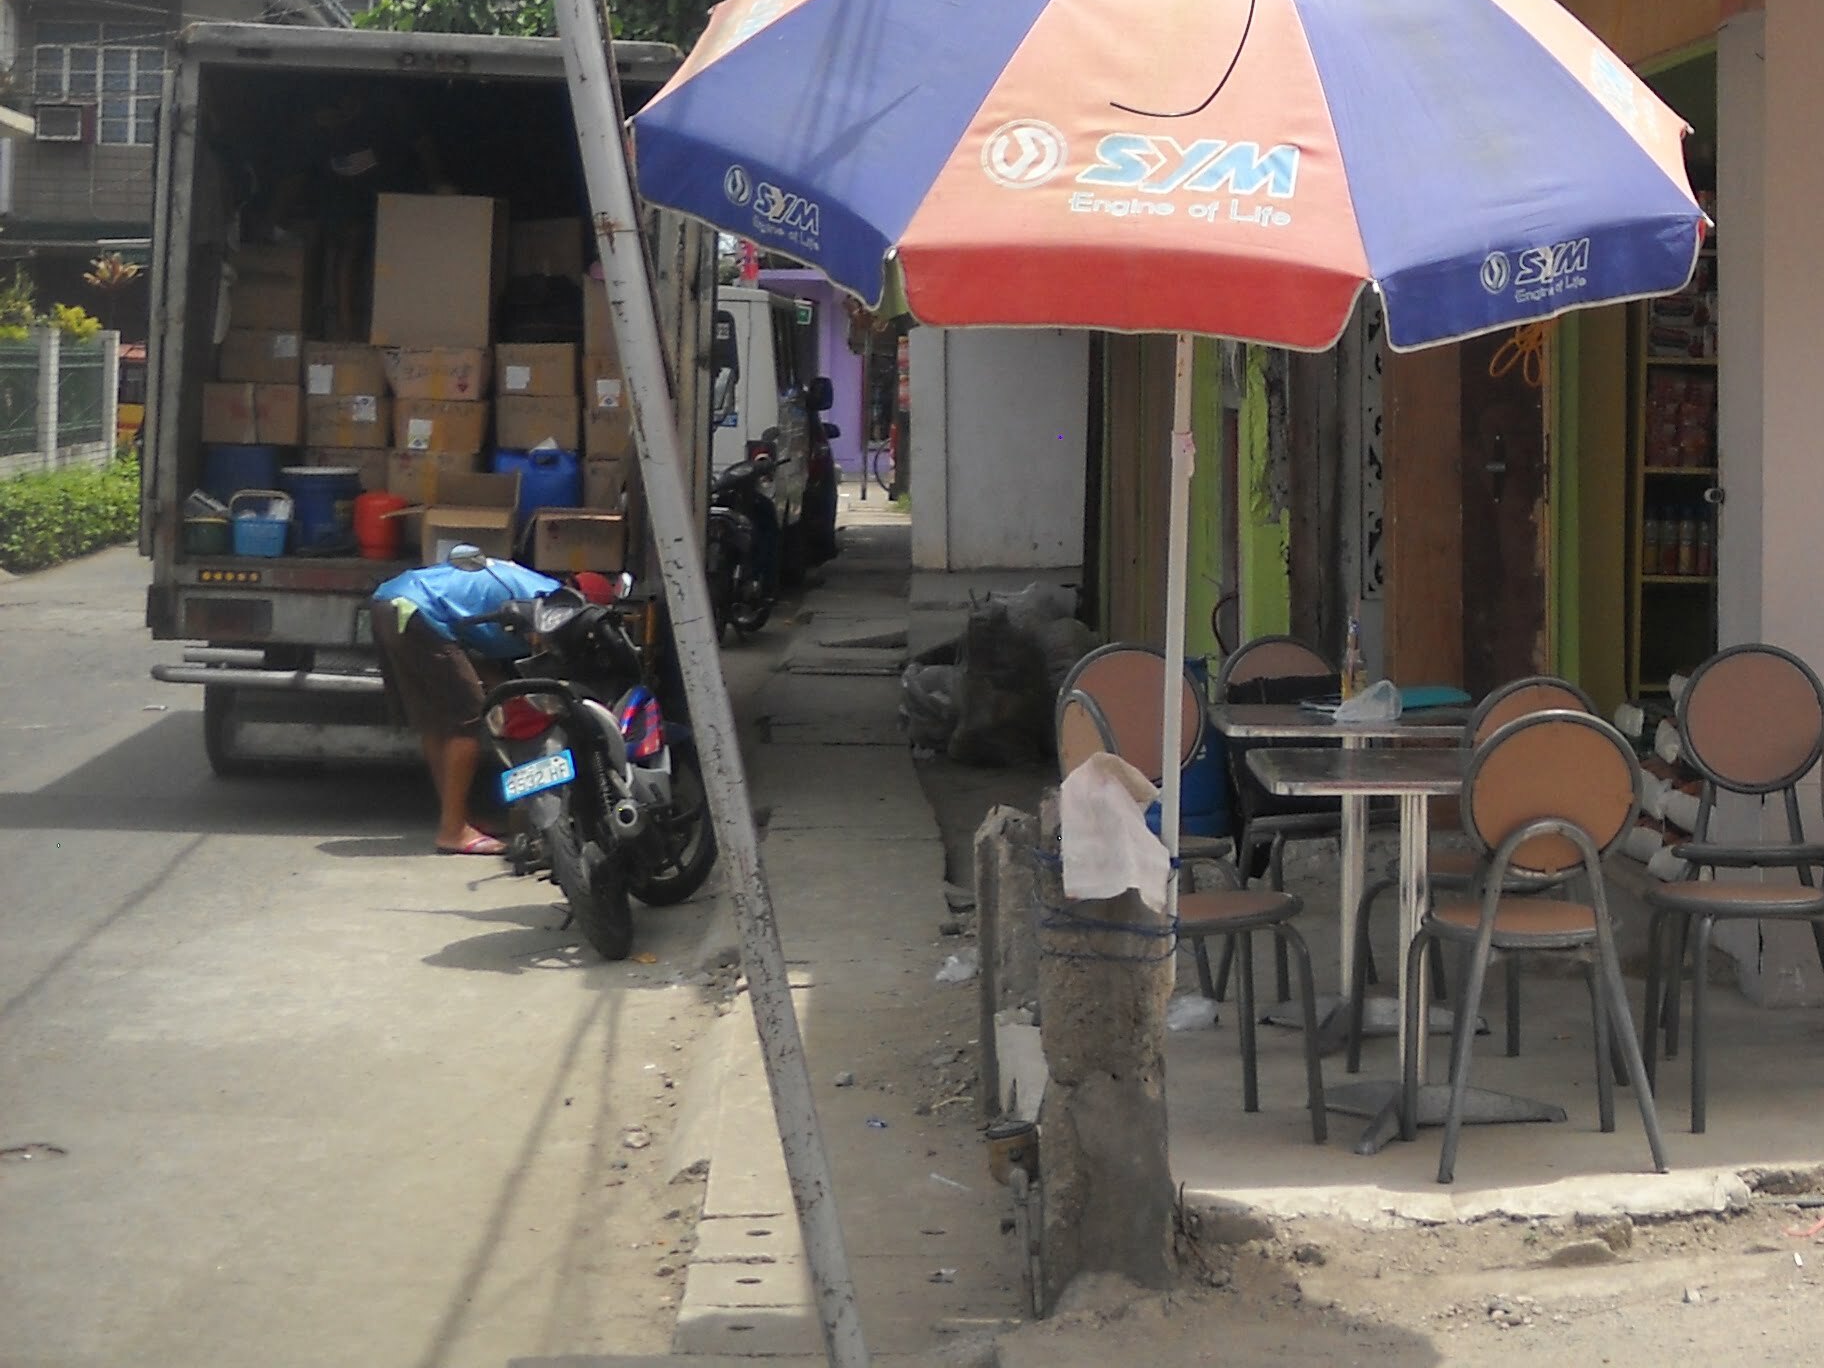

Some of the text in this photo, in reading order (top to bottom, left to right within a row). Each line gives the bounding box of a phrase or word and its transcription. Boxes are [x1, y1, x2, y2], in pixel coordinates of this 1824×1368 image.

[1074, 131, 1301, 199] SYM
[752, 181, 820, 236] SYM
[1067, 190, 1292, 227] Engine of Life
[1513, 237, 1590, 286] SYM
